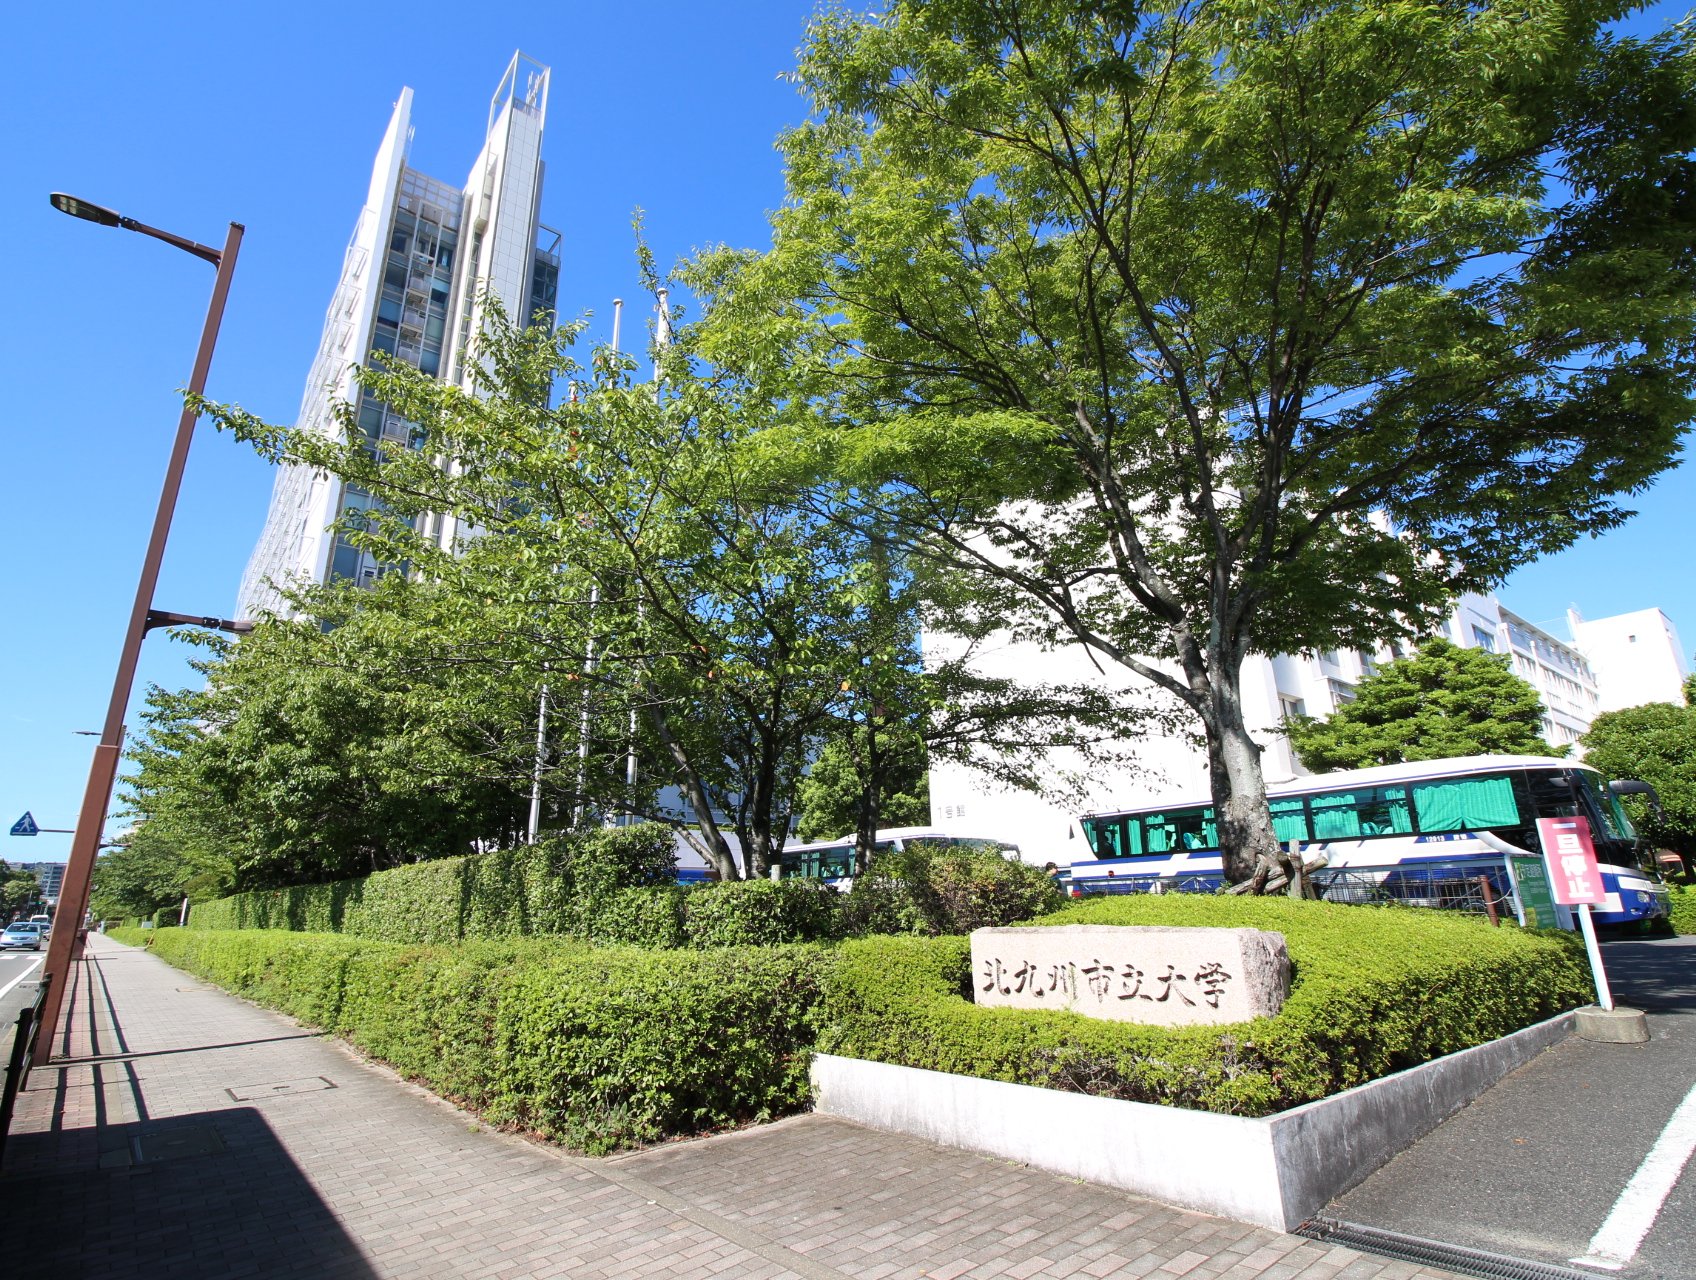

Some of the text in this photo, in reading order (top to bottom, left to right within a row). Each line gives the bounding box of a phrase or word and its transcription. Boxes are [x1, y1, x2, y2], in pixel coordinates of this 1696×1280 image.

[1551, 822, 1594, 898] 一旦停止
[983, 958, 1232, 1009] 北九州市立大学
